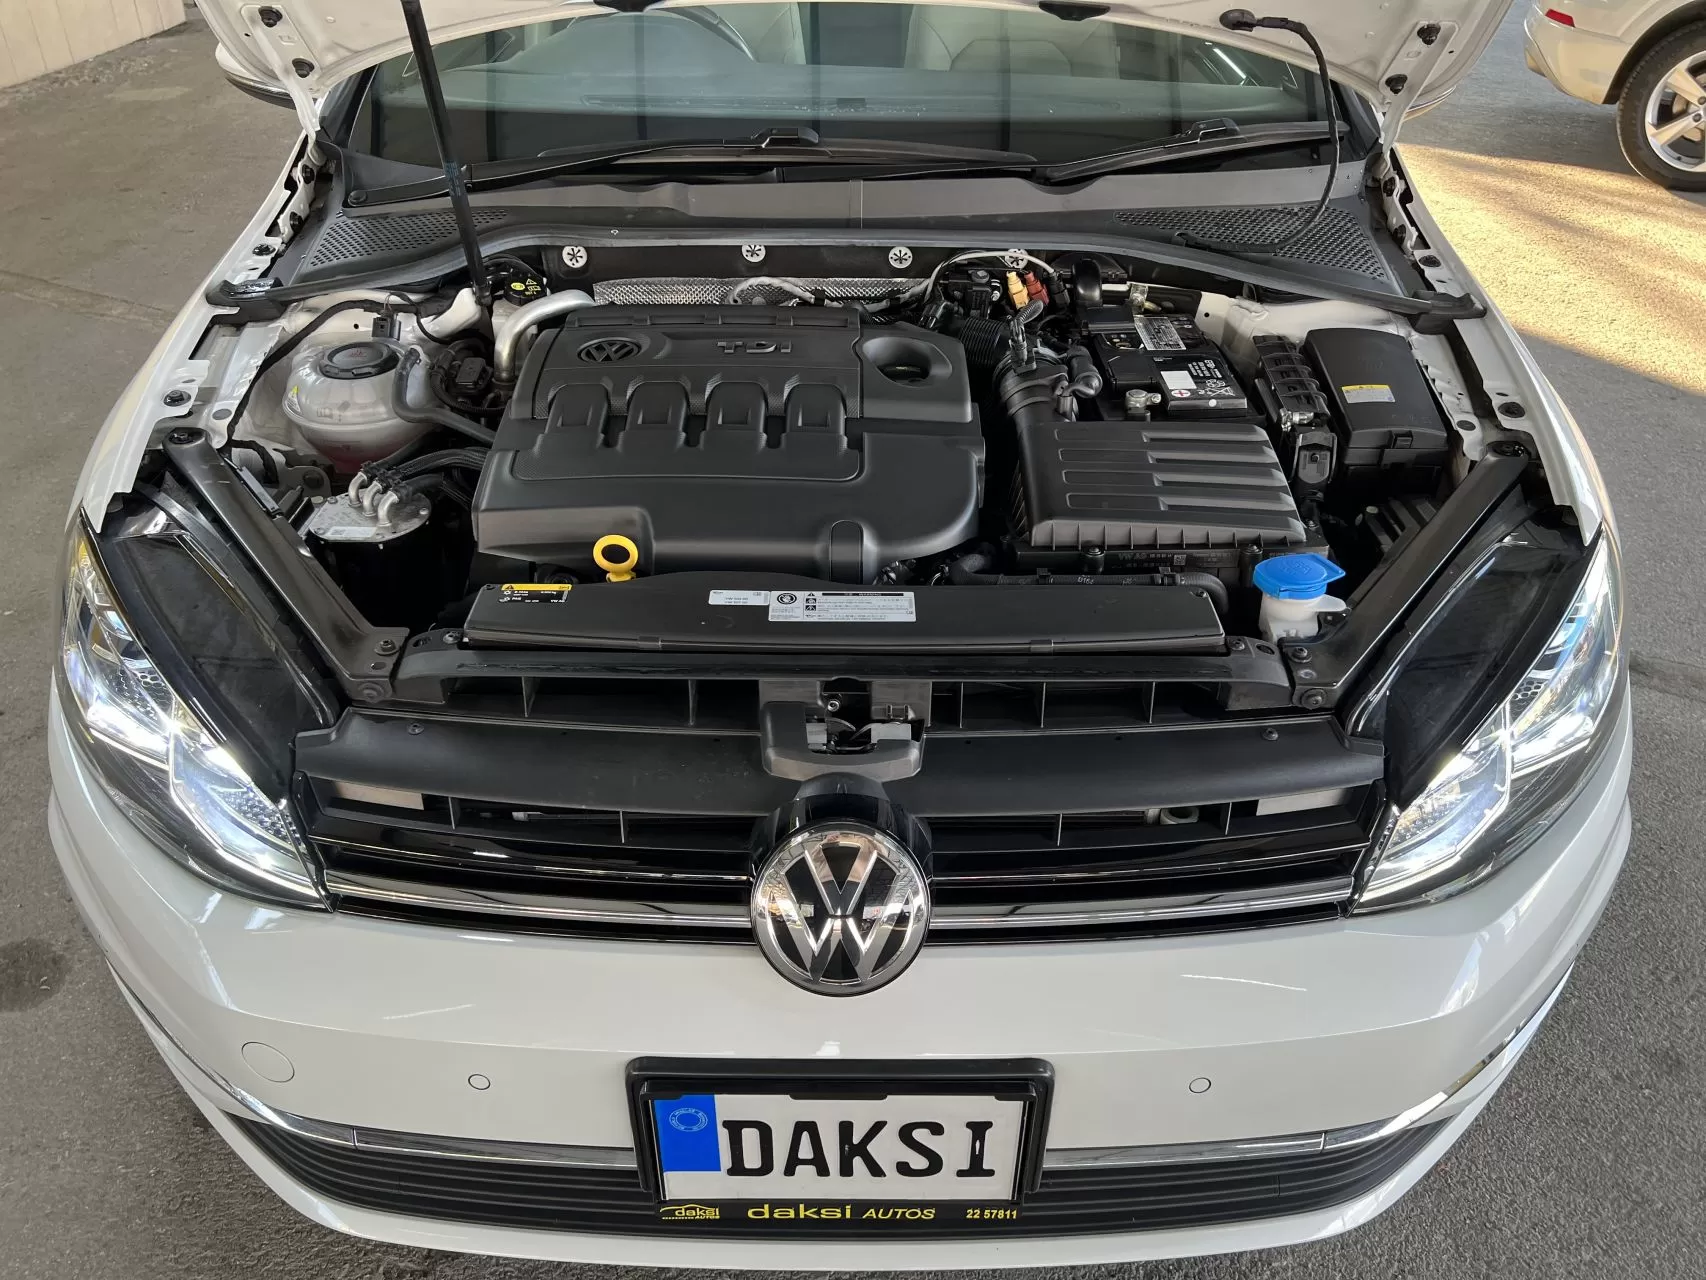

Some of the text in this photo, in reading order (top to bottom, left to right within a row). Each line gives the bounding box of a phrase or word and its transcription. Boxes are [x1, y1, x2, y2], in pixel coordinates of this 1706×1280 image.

[579, 337, 640, 362] VW
[717, 340, 792, 353] TDI
[758, 836, 924, 991] VW
[722, 1120, 996, 1178] DAKSI
[747, 1203, 1017, 1220] daksi AUTOS 22 57811
